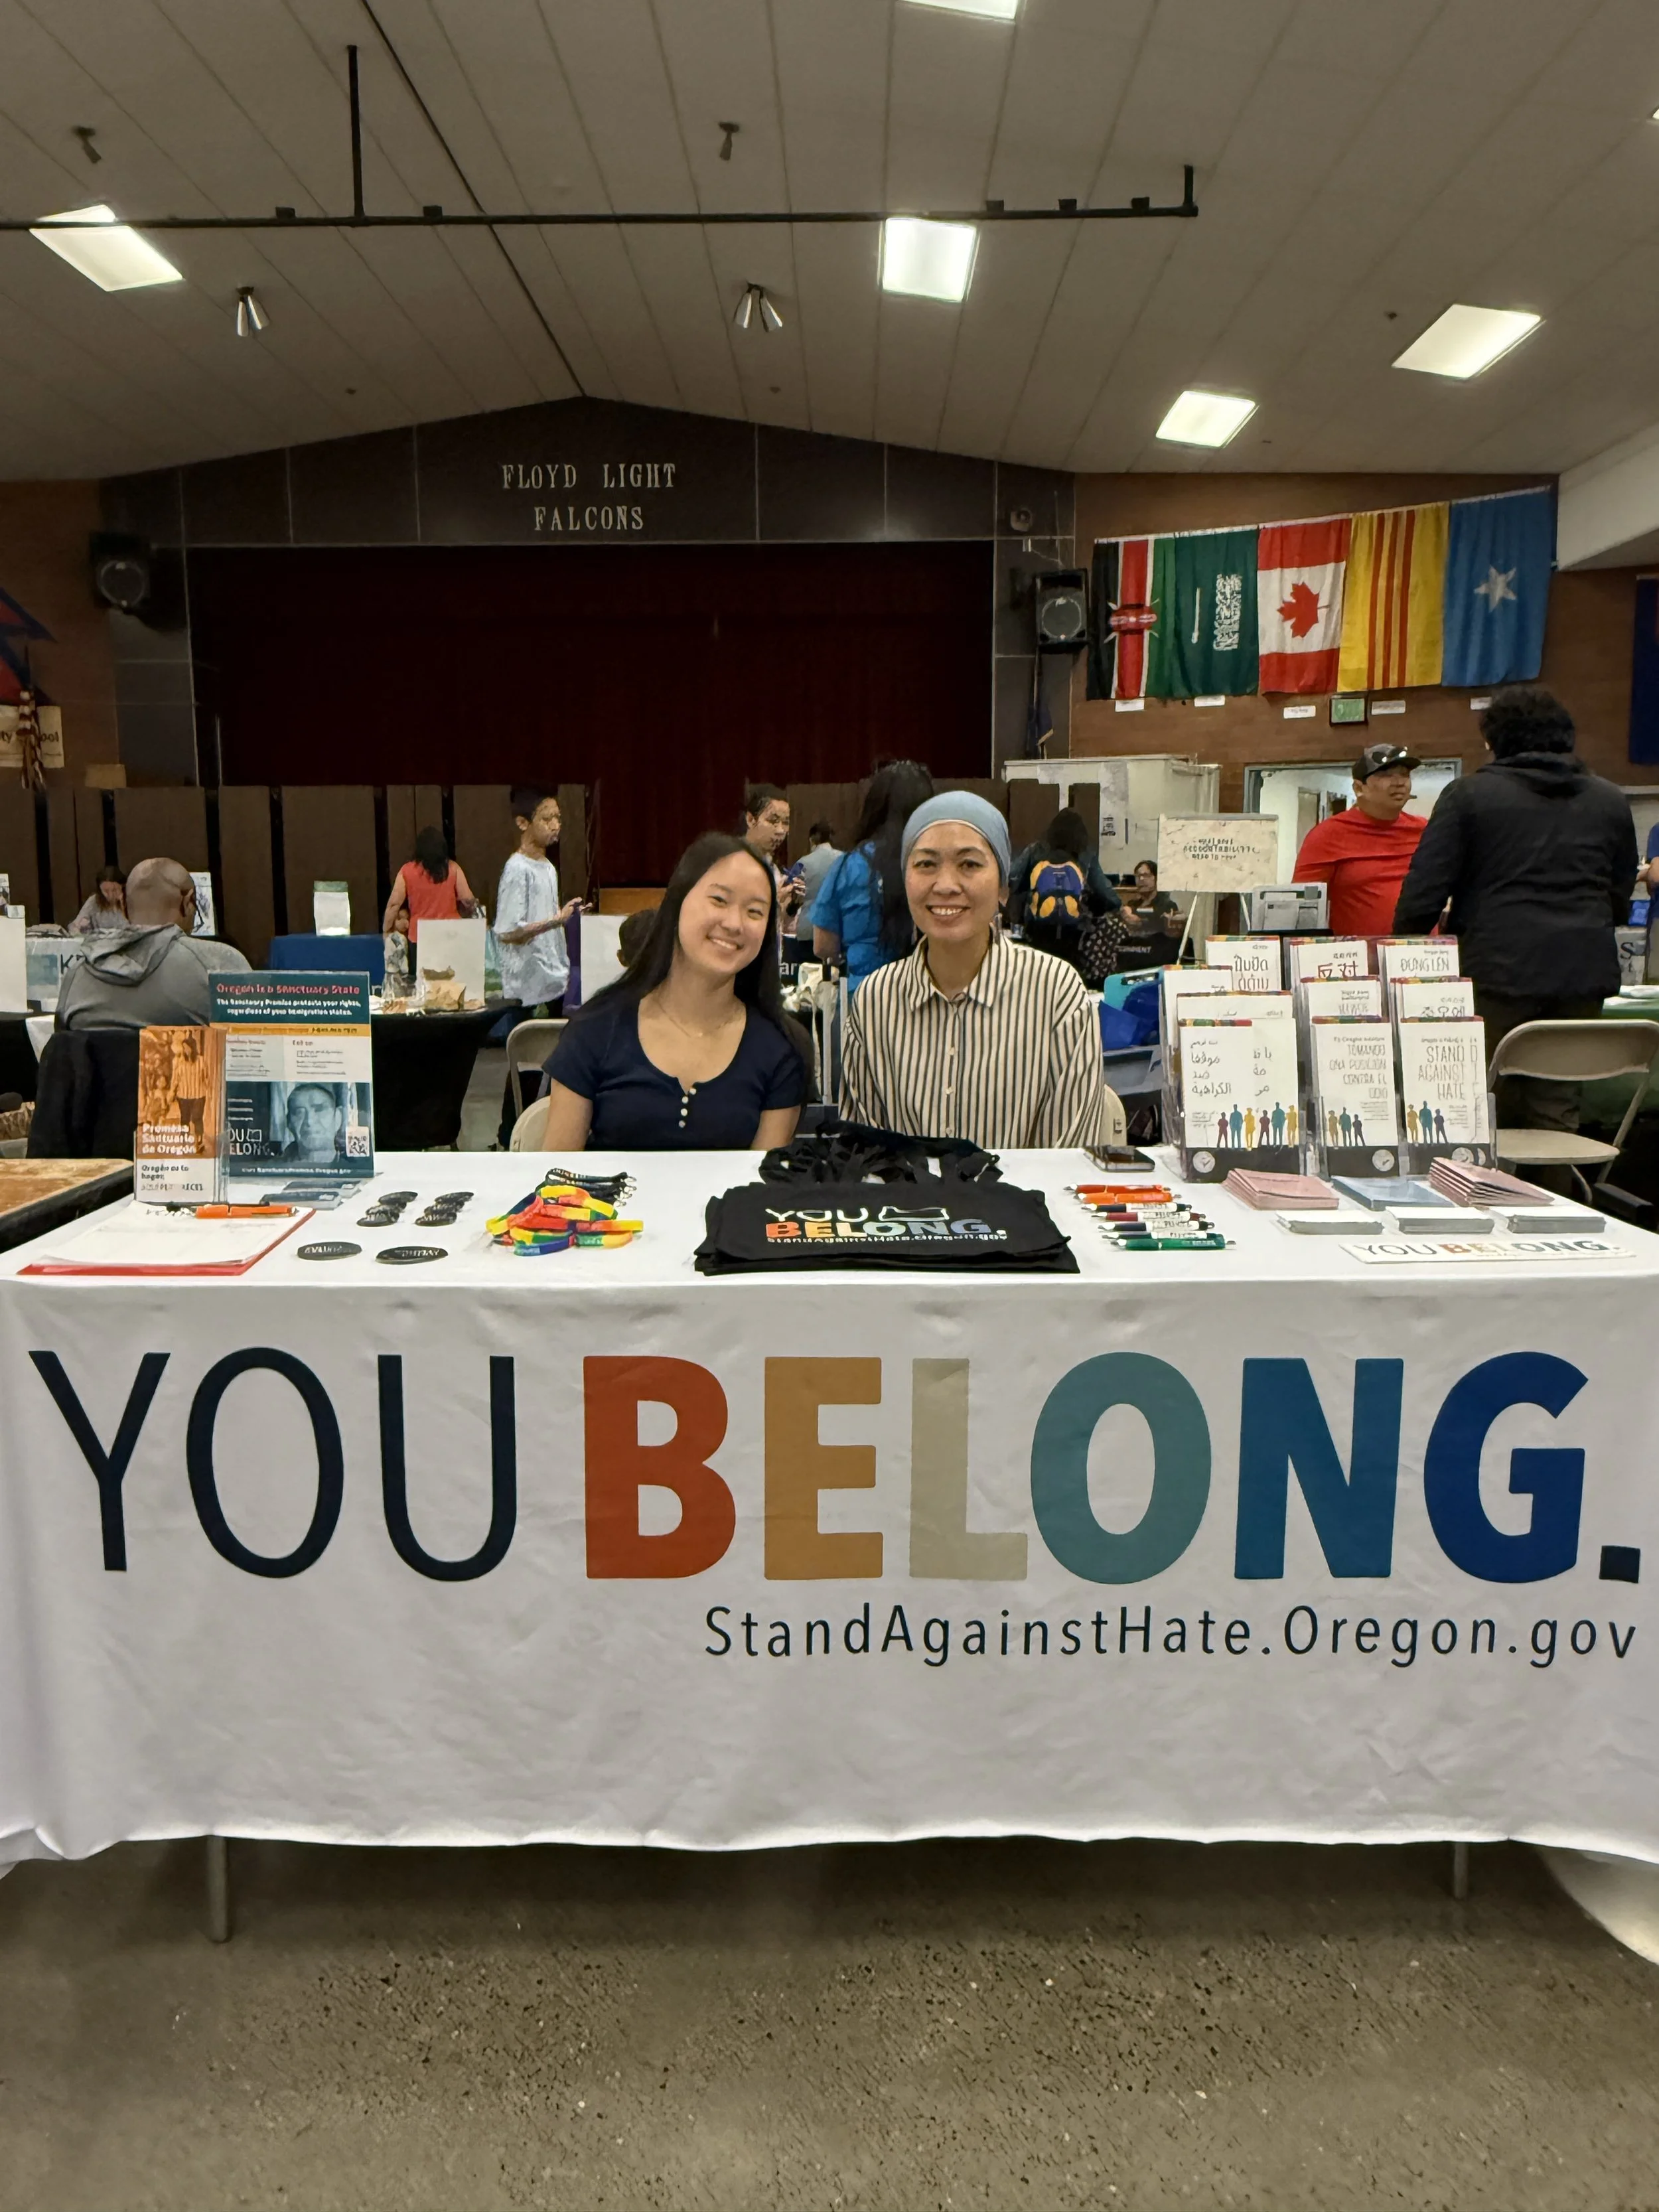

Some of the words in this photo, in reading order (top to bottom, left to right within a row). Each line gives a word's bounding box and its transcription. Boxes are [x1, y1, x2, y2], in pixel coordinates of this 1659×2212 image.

[502, 465, 577, 489] FLOYD
[603, 463, 676, 488] LIGHT
[534, 505, 644, 531] FALCONS
[1426, 1045, 1465, 1063] STAND
[1418, 1063, 1465, 1082] AGAINST
[1437, 1082, 1465, 1100] HATE
[764, 1207, 869, 1222] YOU
[1353, 1244, 1437, 1255] YOU
[29, 1347, 518, 1582] YOU
[583, 1351, 1640, 1585] BELONG.
[705, 1601, 1636, 1668] StandAgainstHate.Oregon.gov
